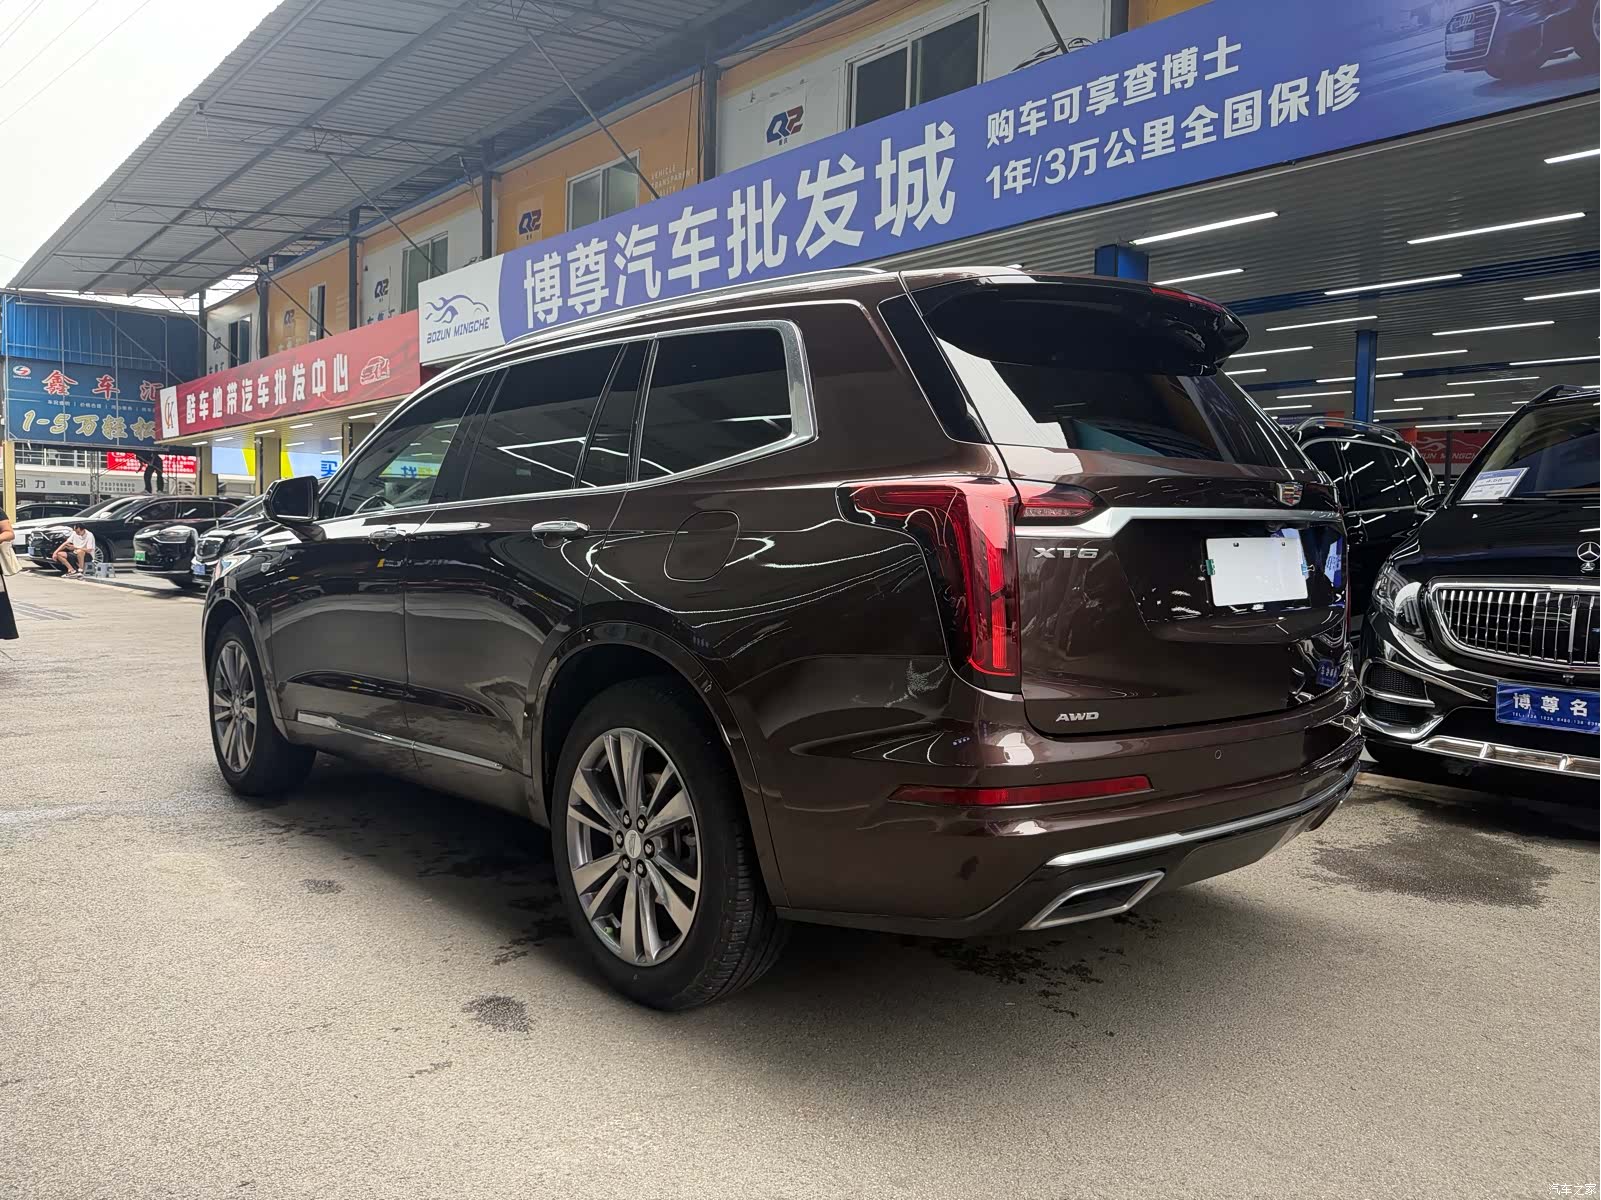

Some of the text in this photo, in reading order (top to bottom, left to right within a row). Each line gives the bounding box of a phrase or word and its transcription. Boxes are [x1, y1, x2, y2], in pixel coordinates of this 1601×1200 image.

[986, 35, 1243, 149] 购车可享查博士
[985, 62, 1361, 201] 1年/3万公里全国保修
[523, 121, 957, 328] 博尊汽车批发城
[453, 317, 490, 337] MINGCHE
[186, 353, 349, 424] 酷车地带汽车批发中心
[1033, 547, 1099, 558] XT6
[1056, 711, 1099, 722] AWD
[1513, 692, 1588, 717] 博尊名
